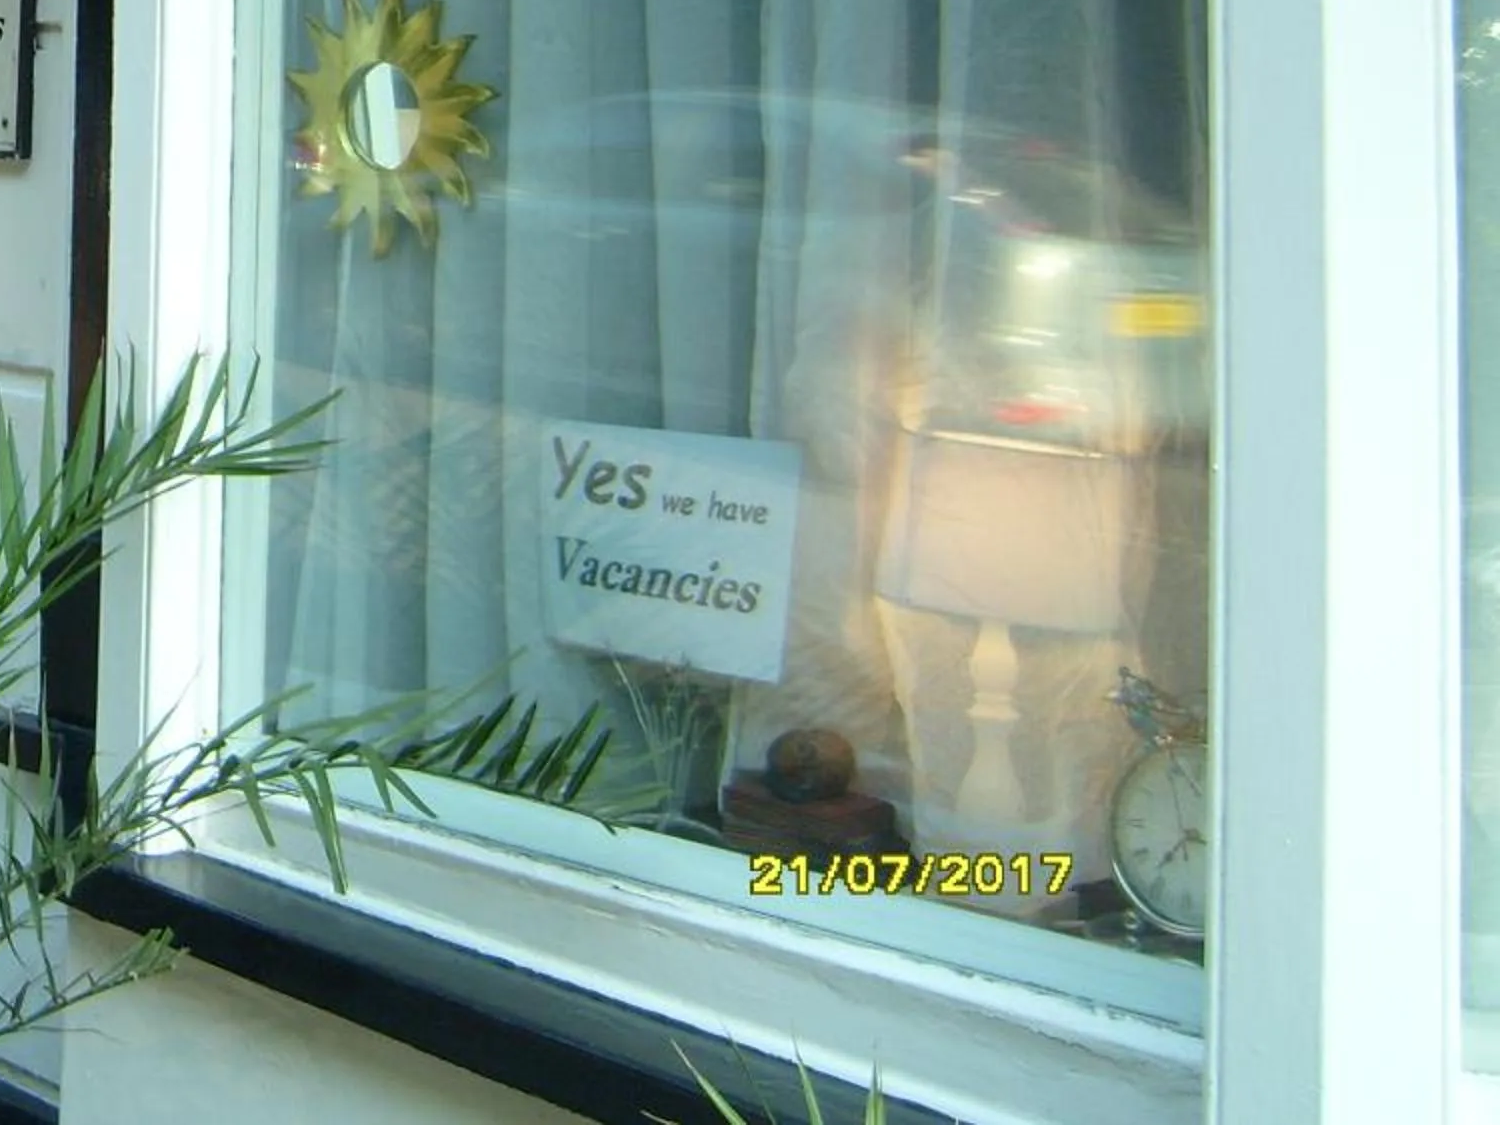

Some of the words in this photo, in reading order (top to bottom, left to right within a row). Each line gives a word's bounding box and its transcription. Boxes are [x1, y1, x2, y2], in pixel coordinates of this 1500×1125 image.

[553, 436, 652, 510] Yes
[662, 493, 696, 516] we
[708, 490, 769, 524] have
[556, 536, 762, 613] Vacancies
